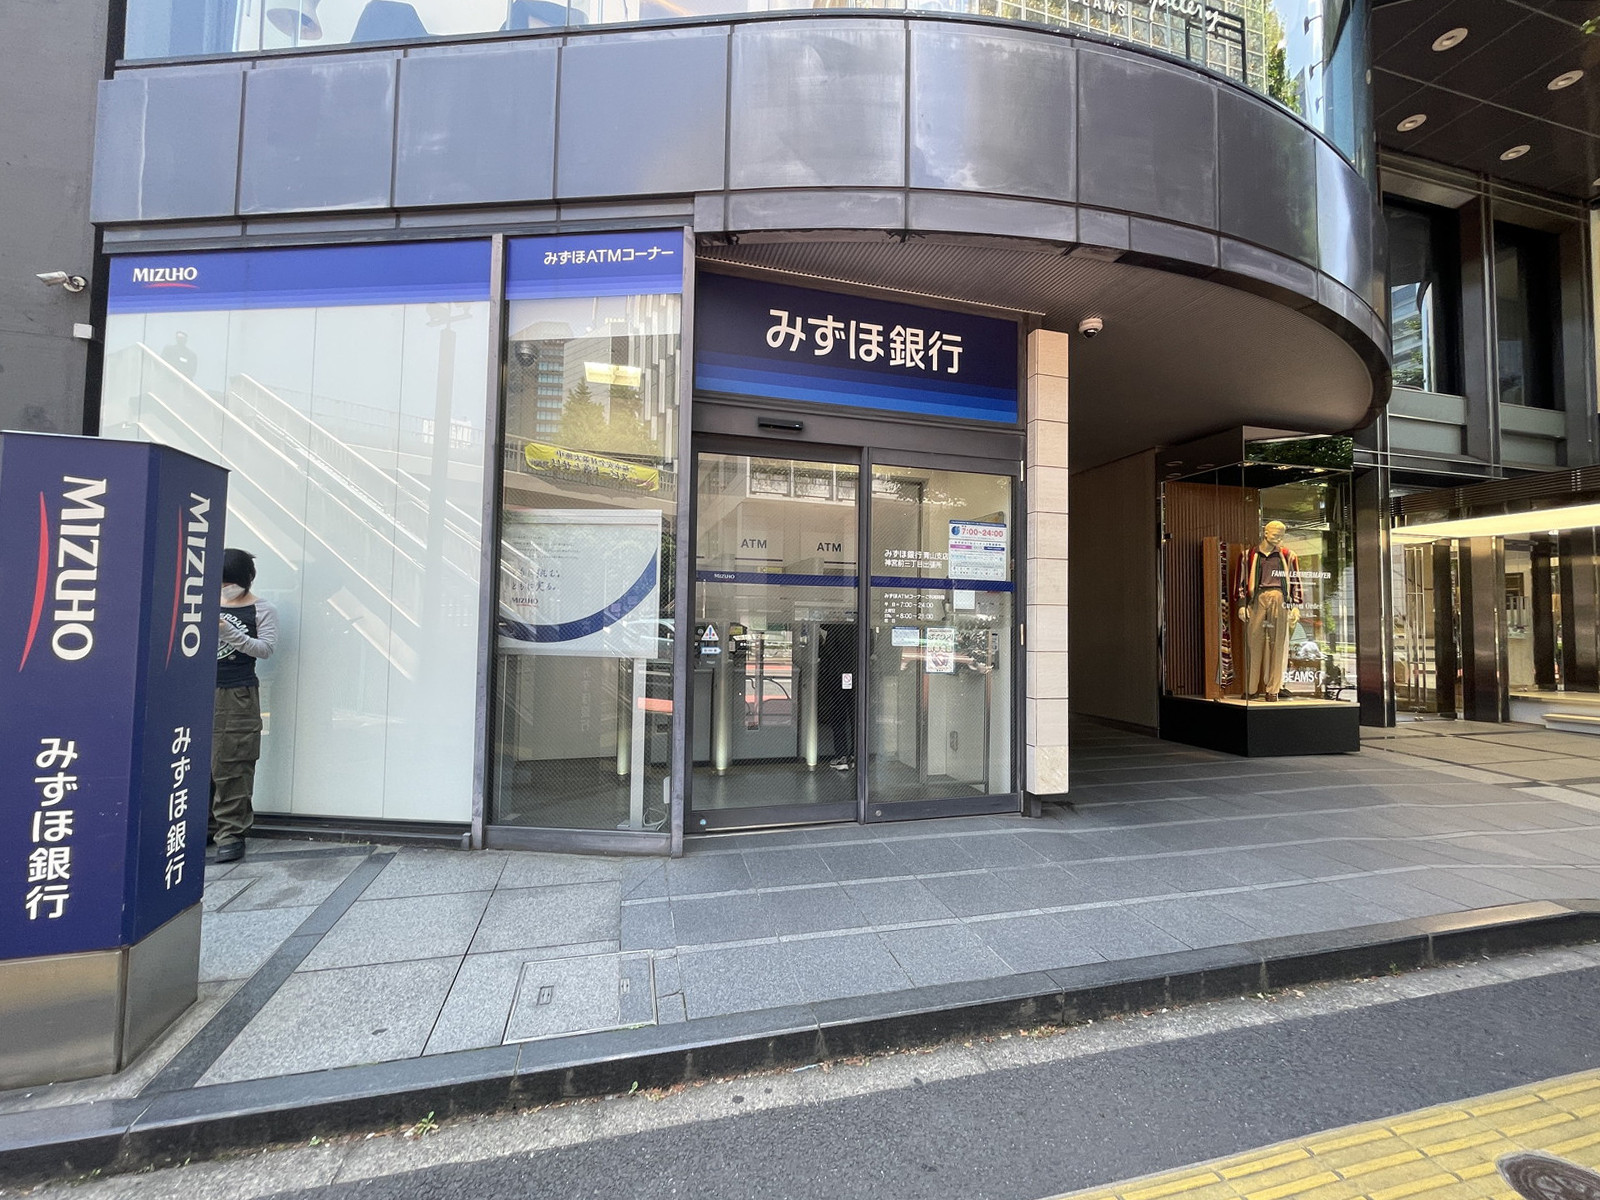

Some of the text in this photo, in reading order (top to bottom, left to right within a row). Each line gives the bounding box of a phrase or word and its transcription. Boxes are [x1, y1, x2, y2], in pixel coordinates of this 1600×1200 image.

[1071, 0, 1126, 17] AMS
[543, 246, 674, 266] みずほATMコーナー
[132, 266, 198, 283] MIZUHO
[766, 308, 963, 374] みずほ銀行
[741, 539, 768, 549] ATM
[817, 542, 842, 552] ATM
[52, 475, 107, 661] MIZUHO
[181, 492, 211, 658] MIZUHO
[1283, 671, 1314, 683] BEAMS
[165, 726, 191, 890] みずほ銀行
[25, 737, 78, 921] みずほ銀行
